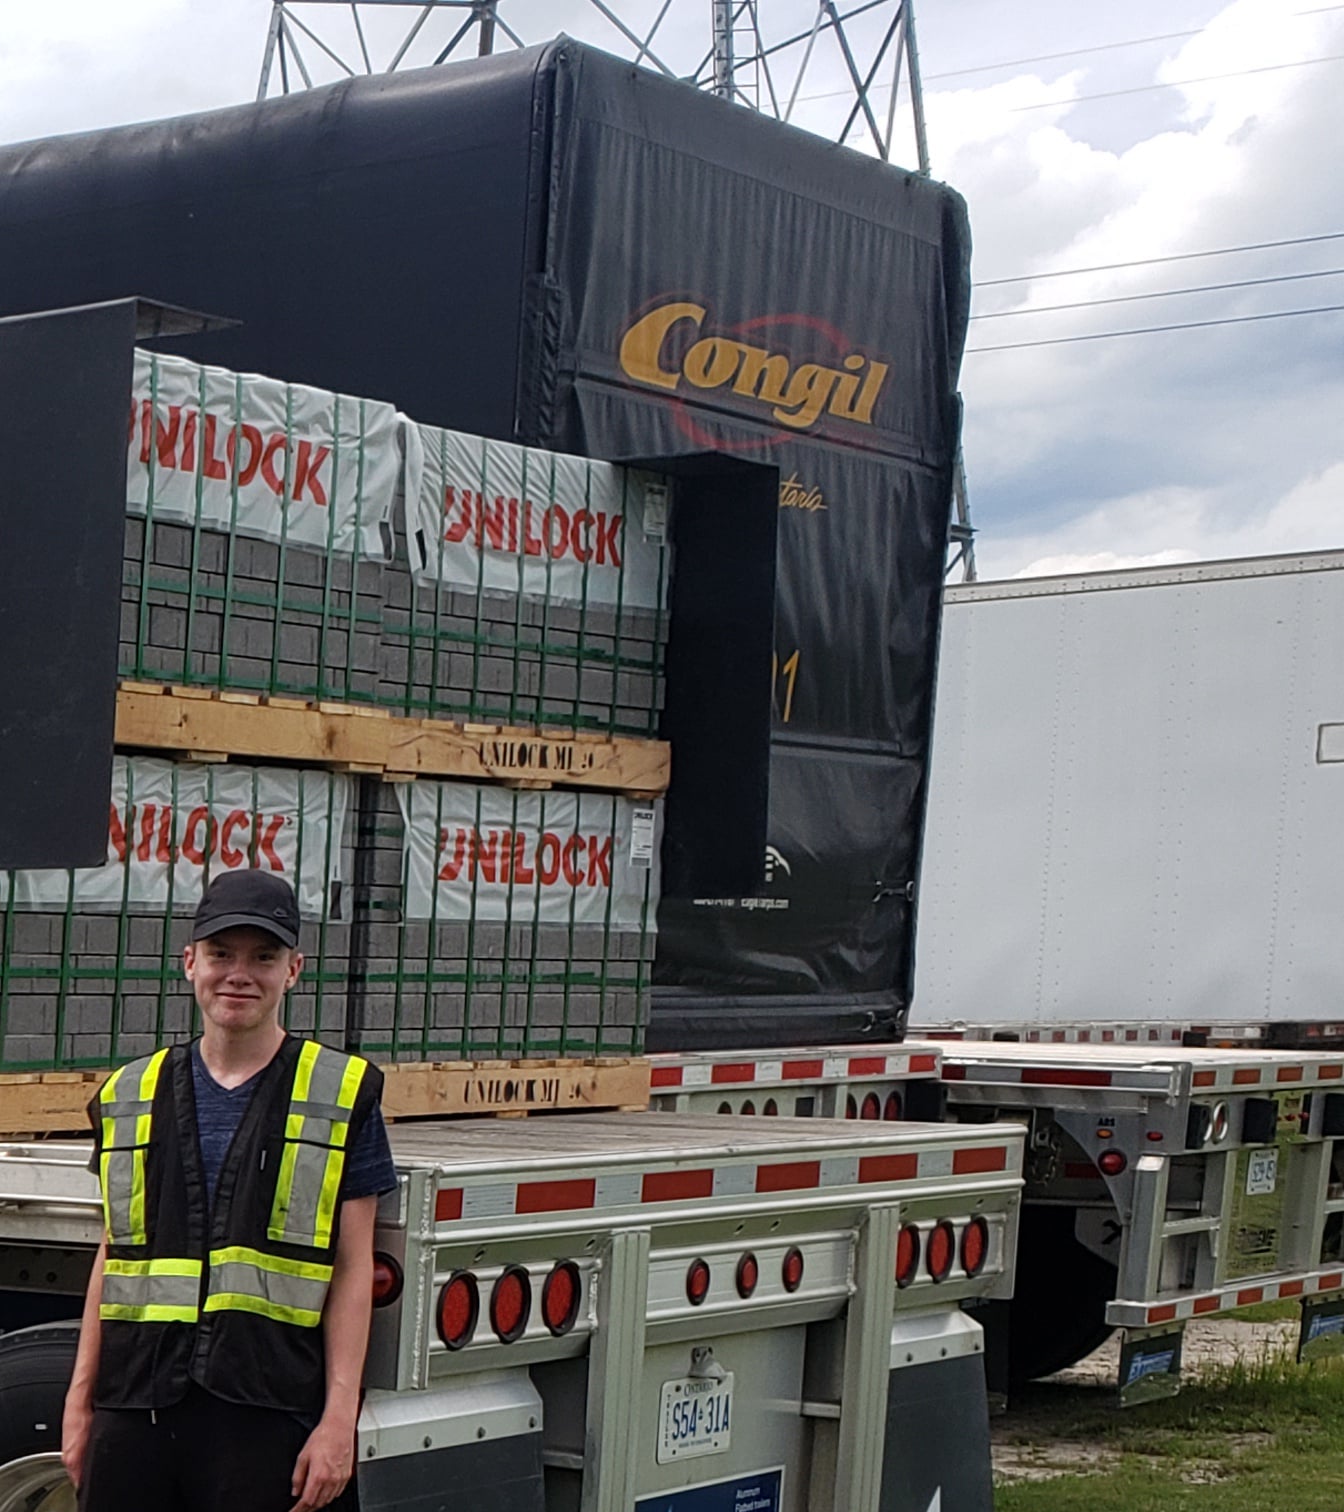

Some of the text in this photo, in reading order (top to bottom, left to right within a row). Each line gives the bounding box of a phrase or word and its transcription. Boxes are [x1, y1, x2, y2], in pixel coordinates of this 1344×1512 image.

[619, 302, 889, 429] Congil
[129, 397, 331, 506] NILOCK
[443, 485, 623, 568] UNILOCK
[479, 742, 548, 769] UNILOCK
[110, 802, 285, 872] NILOCK
[438, 827, 612, 888] UNILOCK
